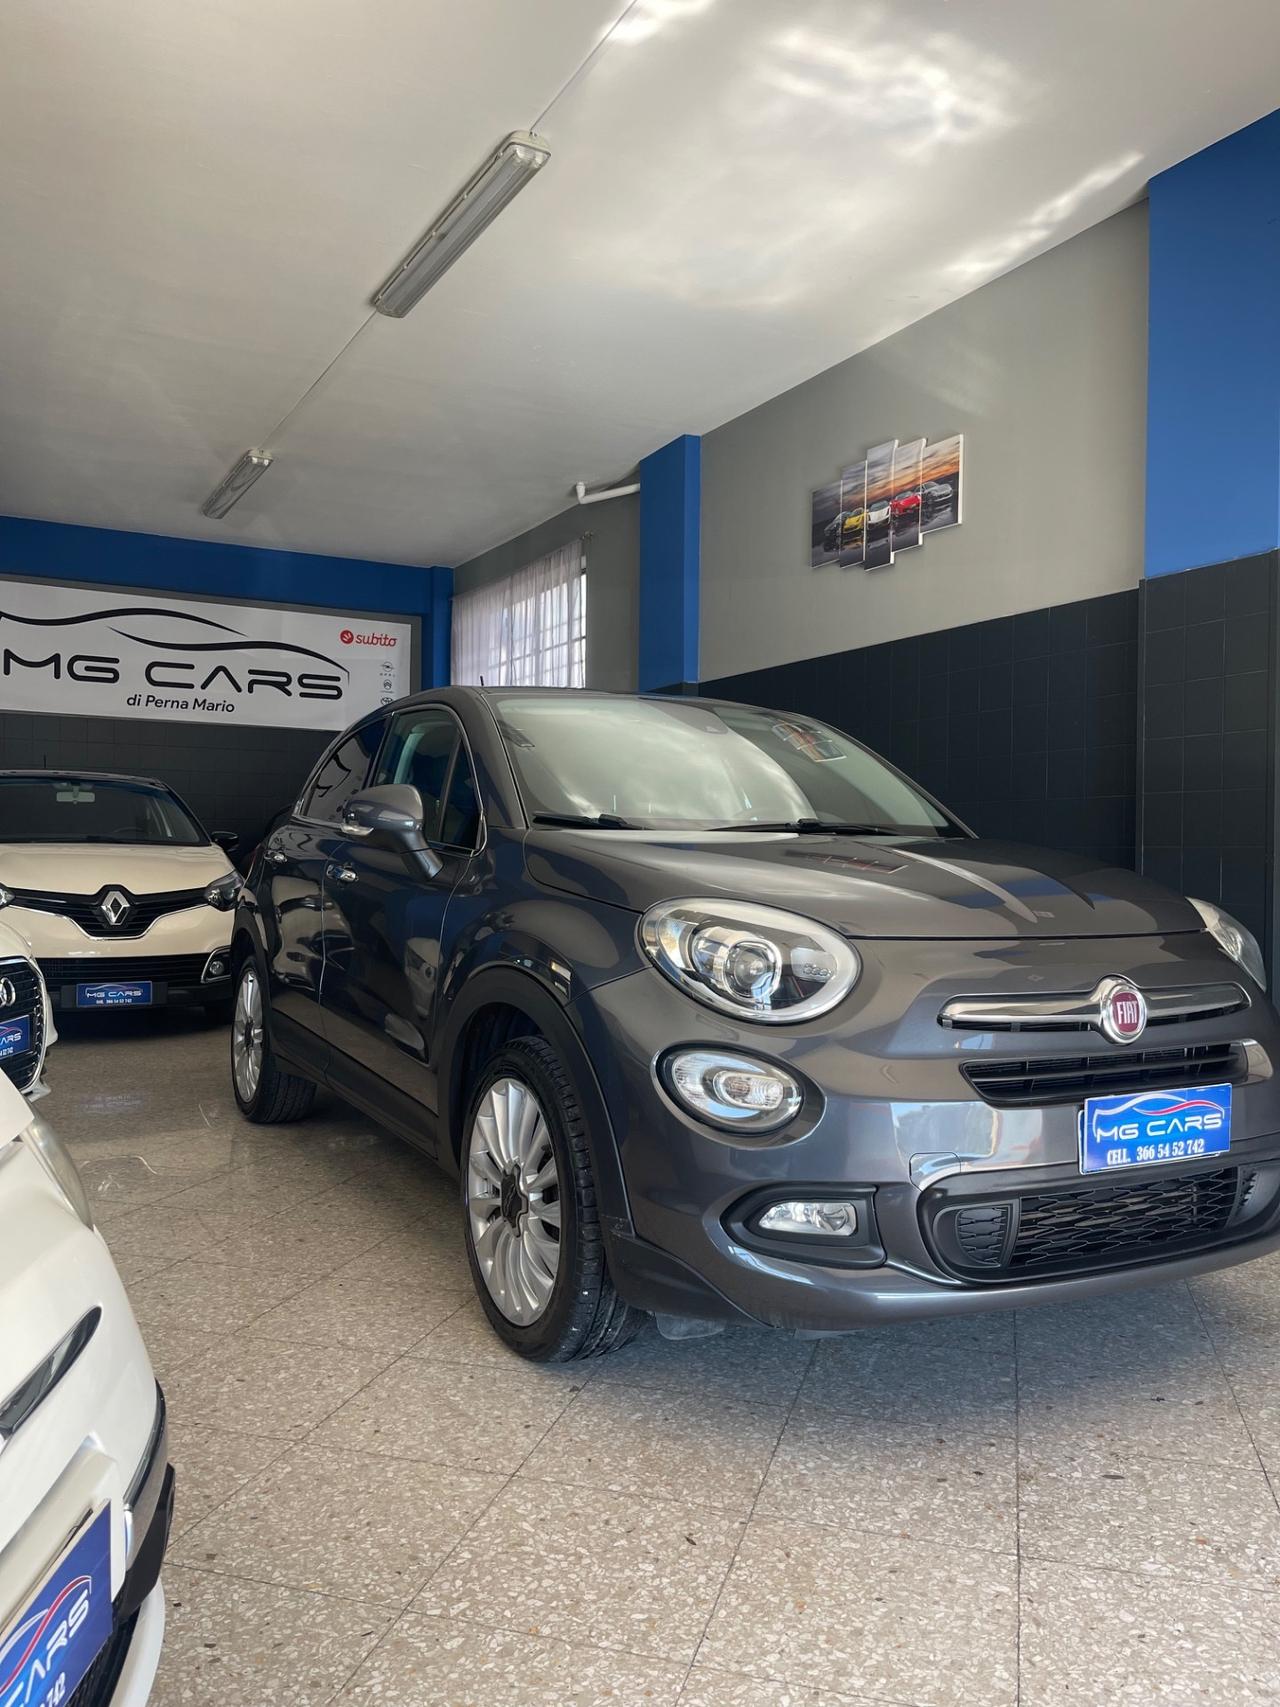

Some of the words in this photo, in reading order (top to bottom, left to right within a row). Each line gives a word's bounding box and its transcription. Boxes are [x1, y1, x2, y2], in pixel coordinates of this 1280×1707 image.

[355, 633, 397, 647] subito
[3, 648, 120, 684] MG
[144, 661, 343, 700] CARS
[126, 694, 142, 707] di
[145, 695, 189, 710] Perna
[192, 698, 235, 713] Mario
[108, 990, 142, 998] CARS
[1116, 1000, 1138, 1025] FIAT
[0, 1032, 22, 1046] ARS
[1096, 1123, 1139, 1143] MG
[1146, 1113, 1222, 1136] CARS
[1107, 1148, 1132, 1166] CELL.
[1136, 1145, 1155, 1162] 366
[1157, 1143, 1170, 1159] 54
[1172, 1141, 1185, 1157] 52
[1187, 1138, 1205, 1155] 742
